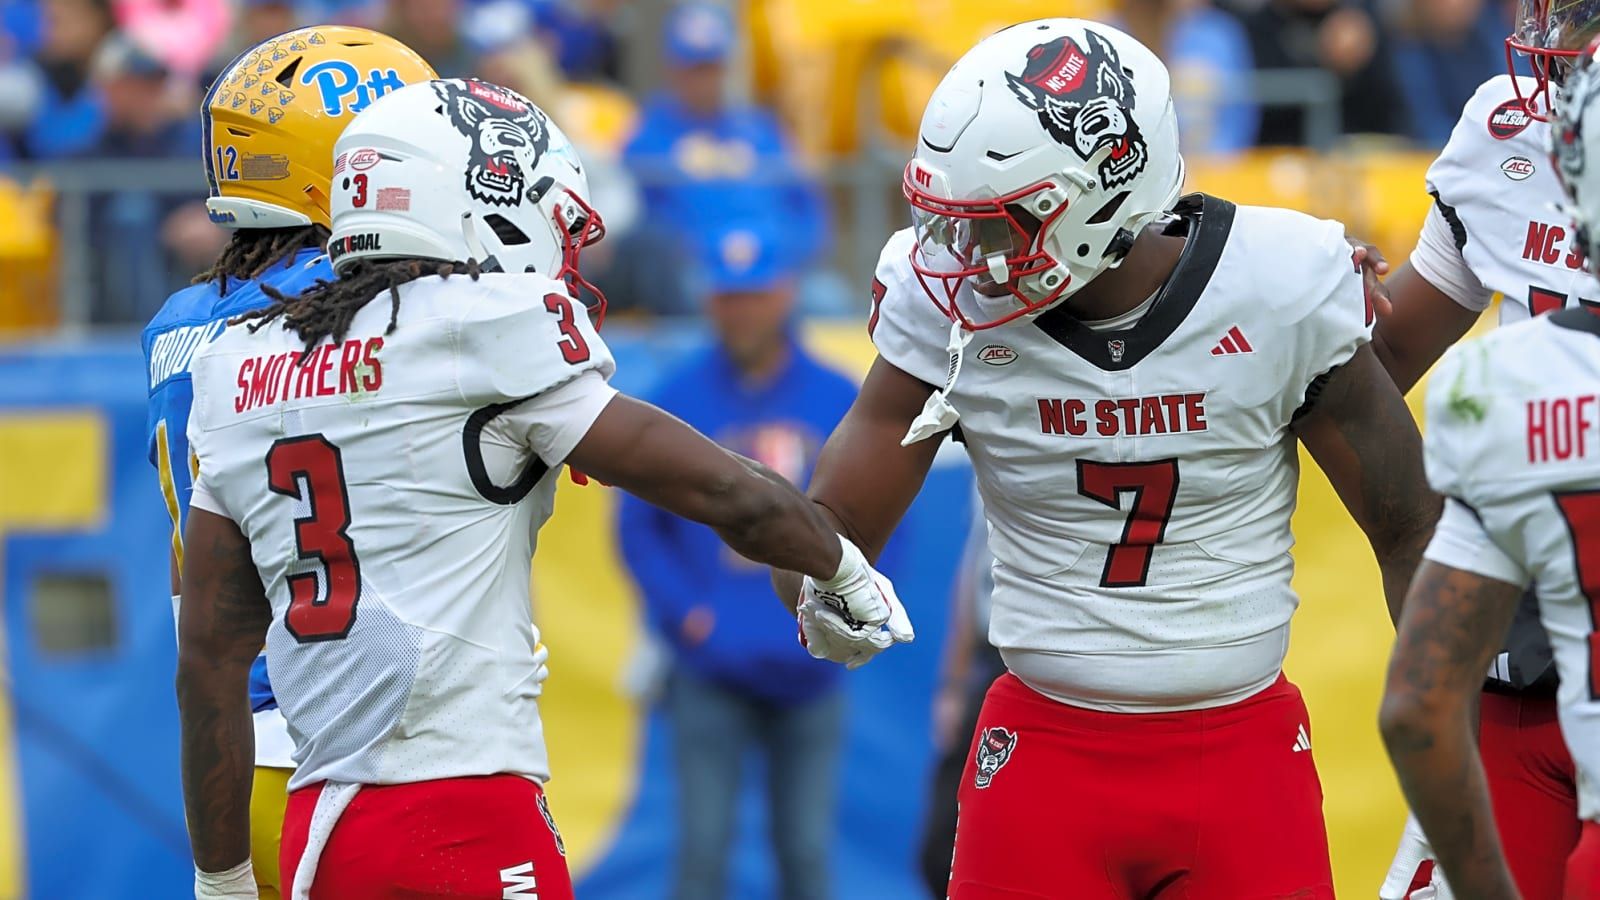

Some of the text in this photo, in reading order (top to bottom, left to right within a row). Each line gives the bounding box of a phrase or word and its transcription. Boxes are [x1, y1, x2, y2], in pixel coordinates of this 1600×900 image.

[301, 59, 406, 116] Pitt
[1045, 53, 1084, 91] NC STATE
[1492, 113, 1530, 126] WILSON
[216, 145, 240, 181] 12
[353, 153, 376, 164] ACC
[1506, 162, 1532, 173] ACC
[352, 173, 368, 208] 3
[1522, 220, 1566, 265] NC
[543, 292, 590, 365] 3
[150, 315, 243, 390] BROOK
[235, 336, 384, 414] SMOTHERS
[984, 349, 1013, 359] ACC
[1037, 392, 1208, 437] NC STATE
[1526, 394, 1600, 465] HOF
[266, 433, 361, 643] 3
[1075, 457, 1180, 588] 7
